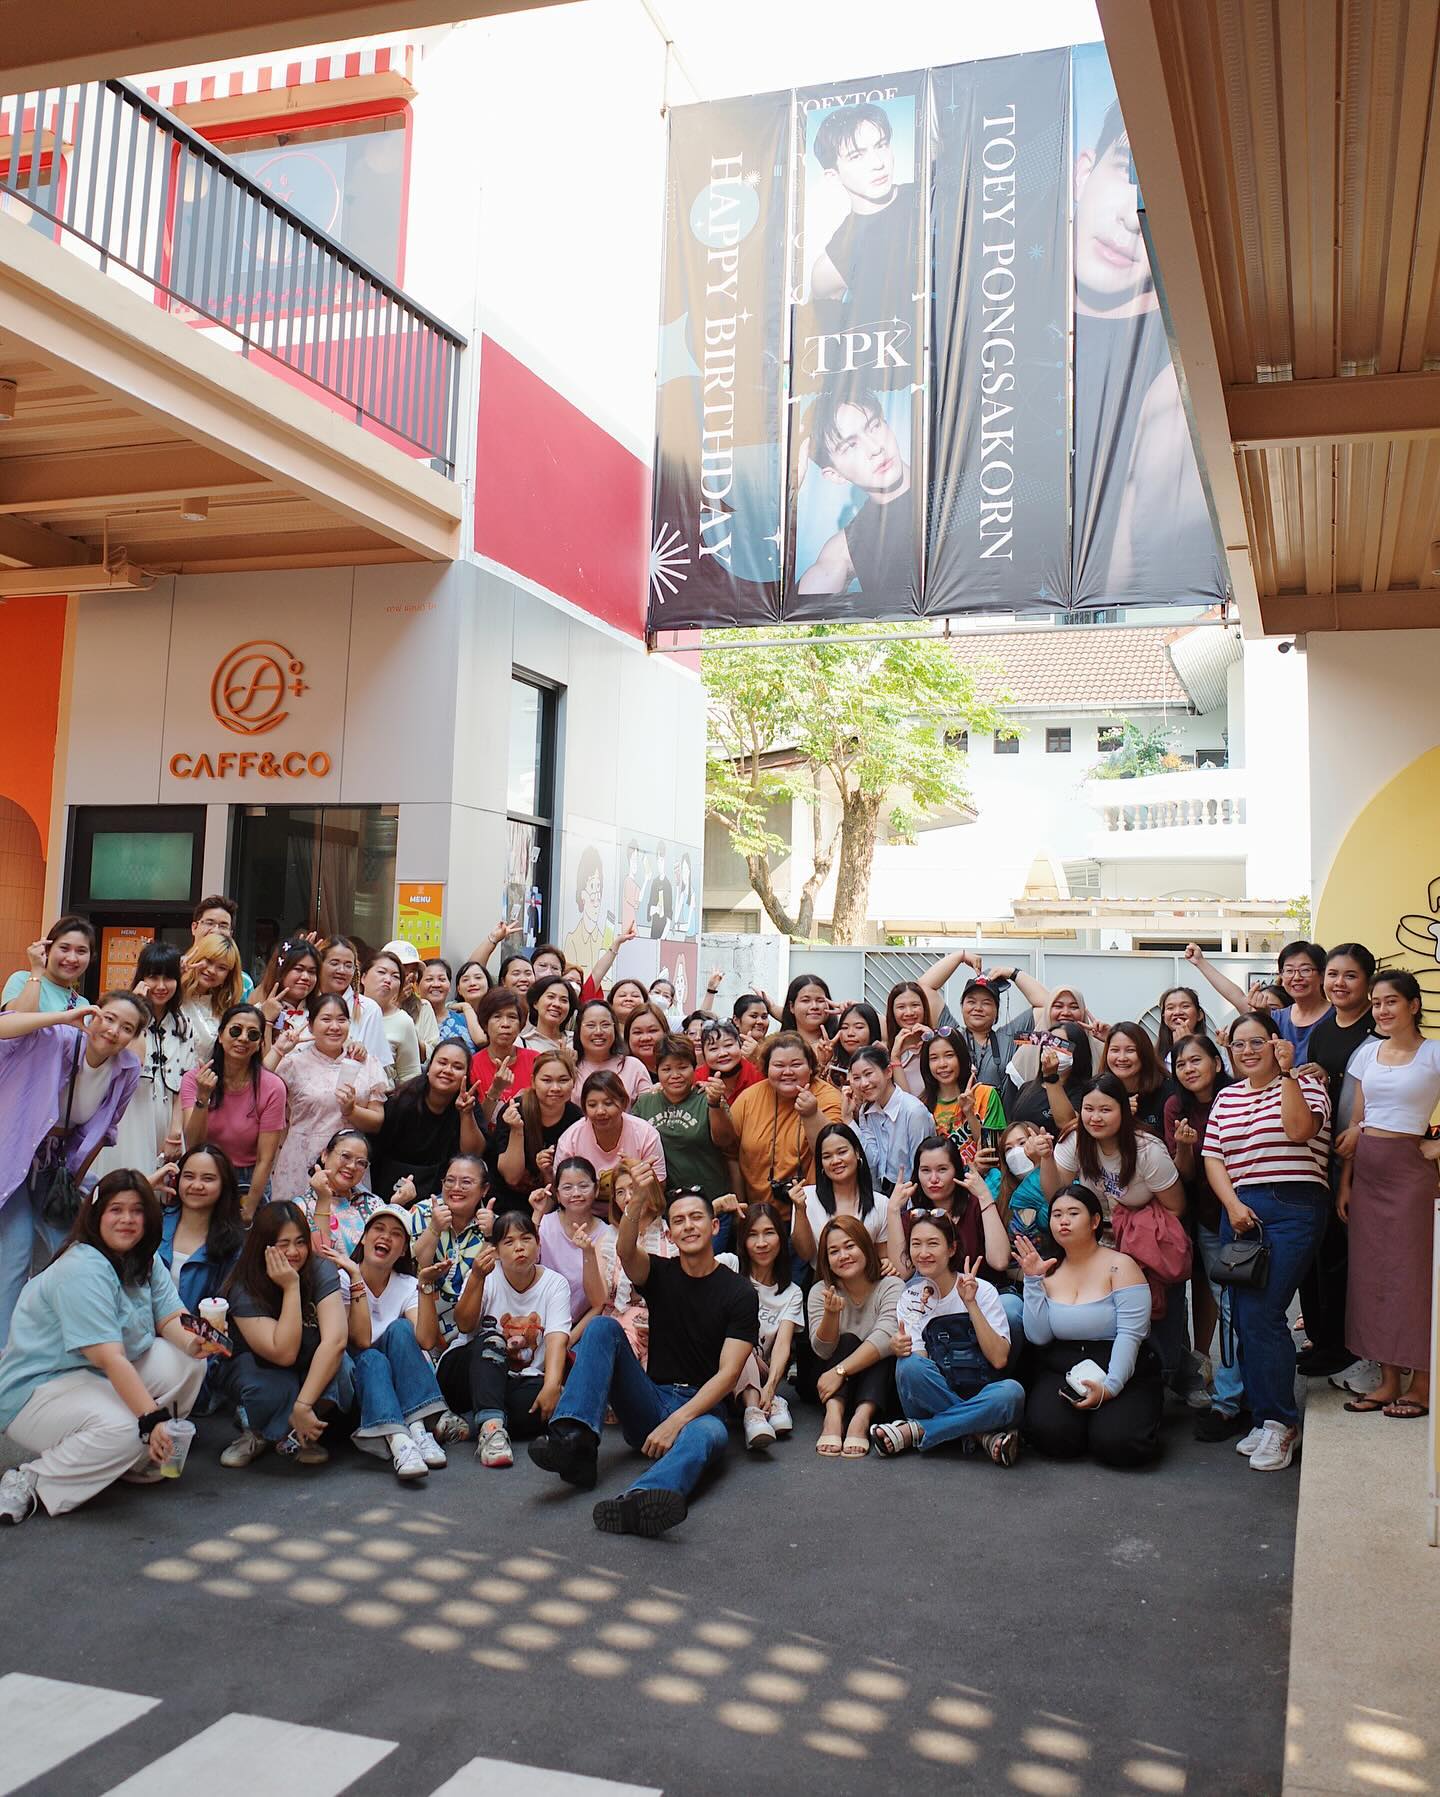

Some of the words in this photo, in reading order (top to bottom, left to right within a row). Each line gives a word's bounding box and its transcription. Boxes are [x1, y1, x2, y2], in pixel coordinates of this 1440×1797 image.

[796, 88, 898, 116] OEYTOE
[982, 104, 1016, 228] TOEY
[706, 152, 743, 301] HAPPY
[804, 329, 911, 373] TPK
[699, 312, 738, 568] BIRTHDAY
[979, 239, 1016, 561] PONGSAKORN
[169, 751, 332, 779] CAFF&CO
[409, 895, 432, 904] MENU
